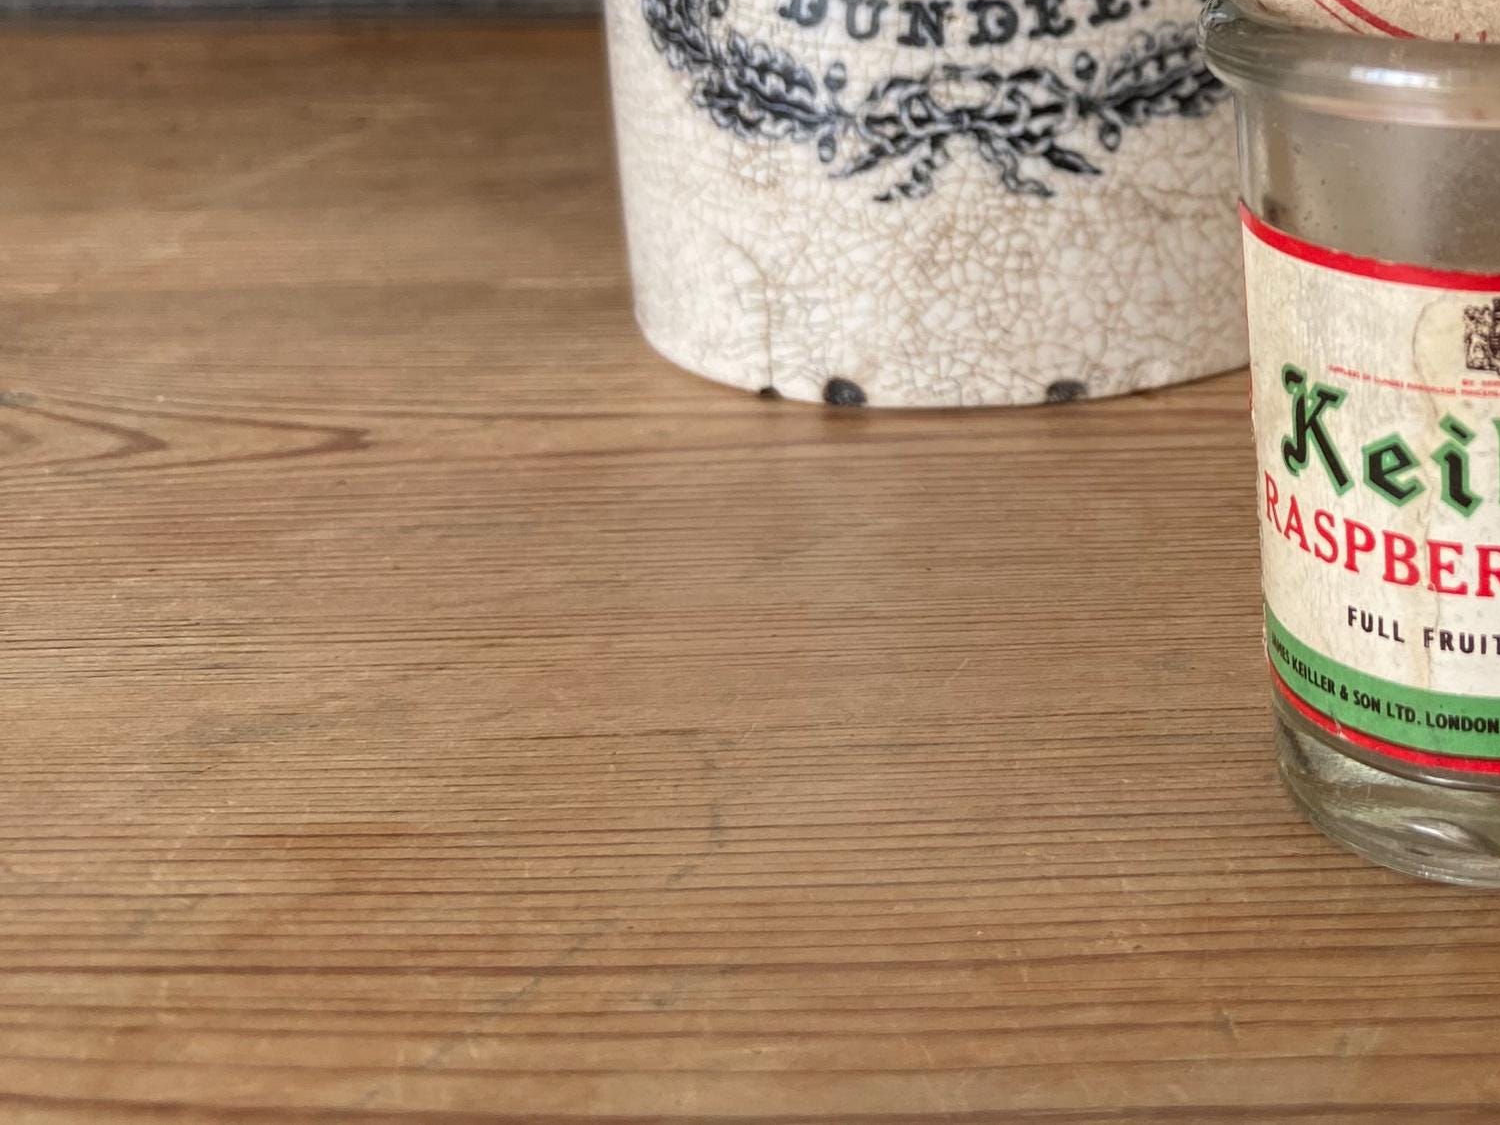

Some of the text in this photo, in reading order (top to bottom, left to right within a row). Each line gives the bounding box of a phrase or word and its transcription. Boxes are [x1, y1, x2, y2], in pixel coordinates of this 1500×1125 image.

[1347, 605, 1405, 644] FULL
[1291, 654, 1336, 696] KEILLER
[1339, 683, 1349, 702] &
[1352, 688, 1381, 714] SON
[1386, 701, 1422, 725] LTD.
